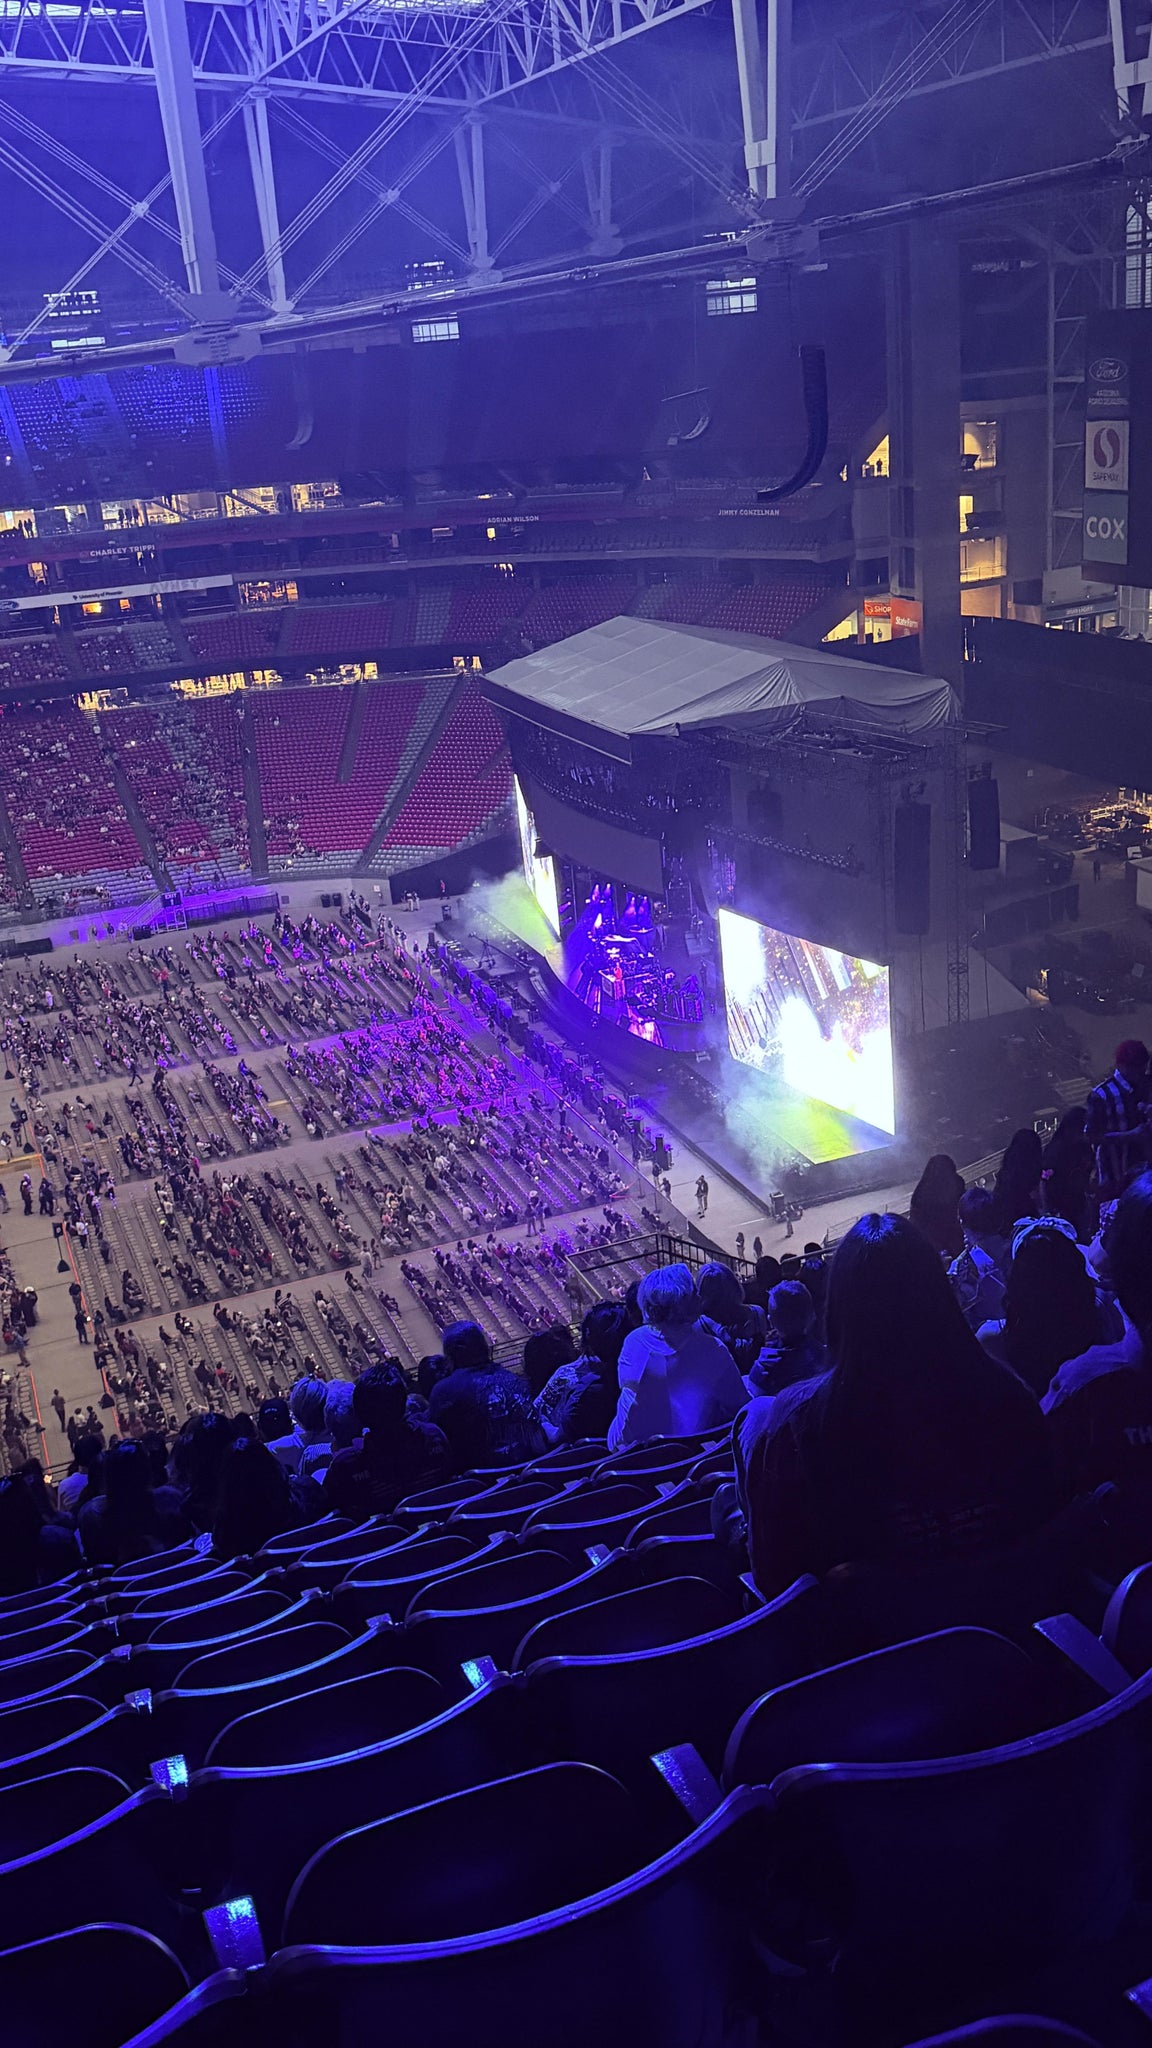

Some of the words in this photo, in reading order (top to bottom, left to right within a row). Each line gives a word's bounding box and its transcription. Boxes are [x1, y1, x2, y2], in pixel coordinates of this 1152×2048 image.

[1092, 471, 1120, 481] SAFEWAY
[718, 509, 738, 517] JIMMY
[739, 508, 780, 517] CONZELMAN
[487, 516, 512, 524] ADRIAN
[513, 515, 539, 523] WILSON
[1086, 516, 1125, 541] COX
[90, 547, 127, 557] CHARLEY
[129, 544, 155, 554] TRIPPI
[874, 605, 892, 613] SHOP
